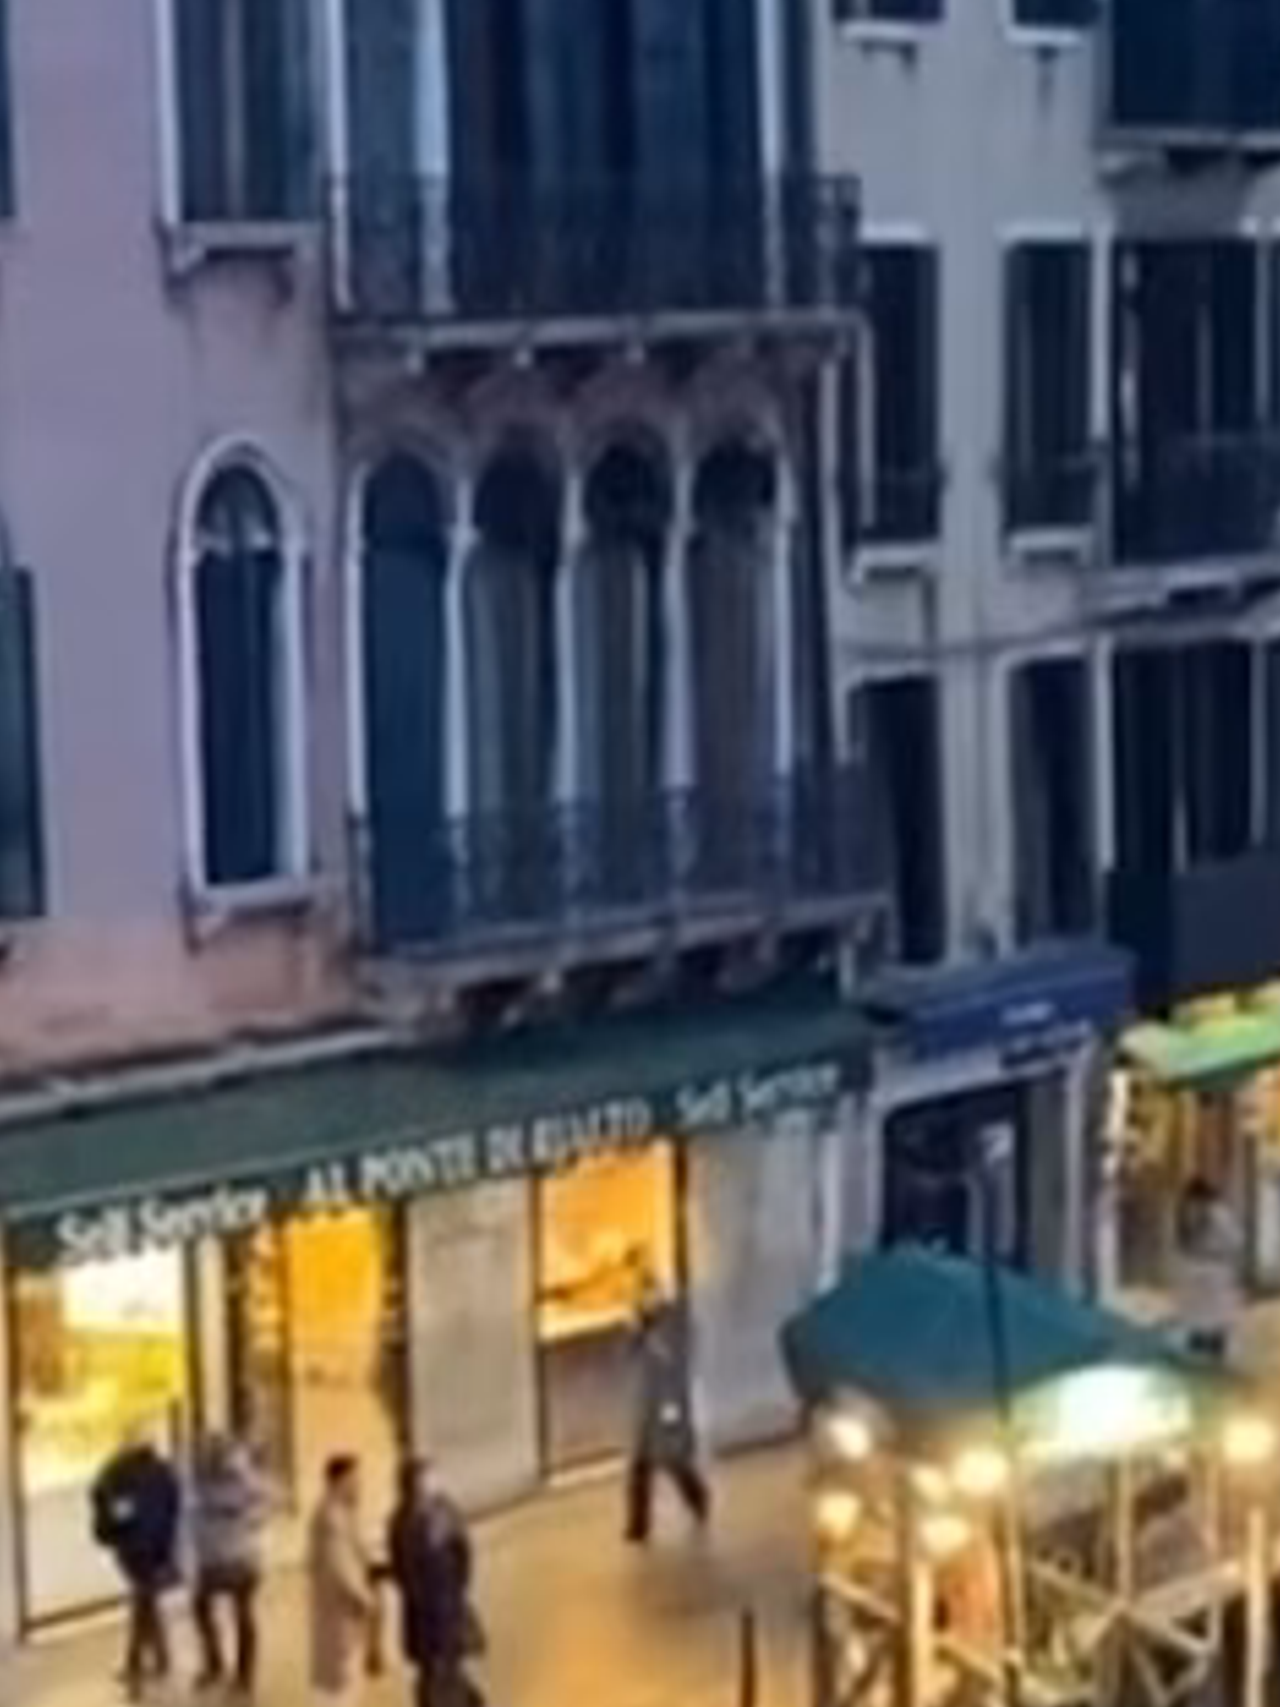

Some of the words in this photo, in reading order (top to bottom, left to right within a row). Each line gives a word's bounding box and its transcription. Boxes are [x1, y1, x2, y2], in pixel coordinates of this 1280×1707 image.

[56, 1204, 131, 1256] Self
[138, 1186, 268, 1241] Service
[361, 1133, 478, 1196] PONTE
[486, 1122, 523, 1171] DI
